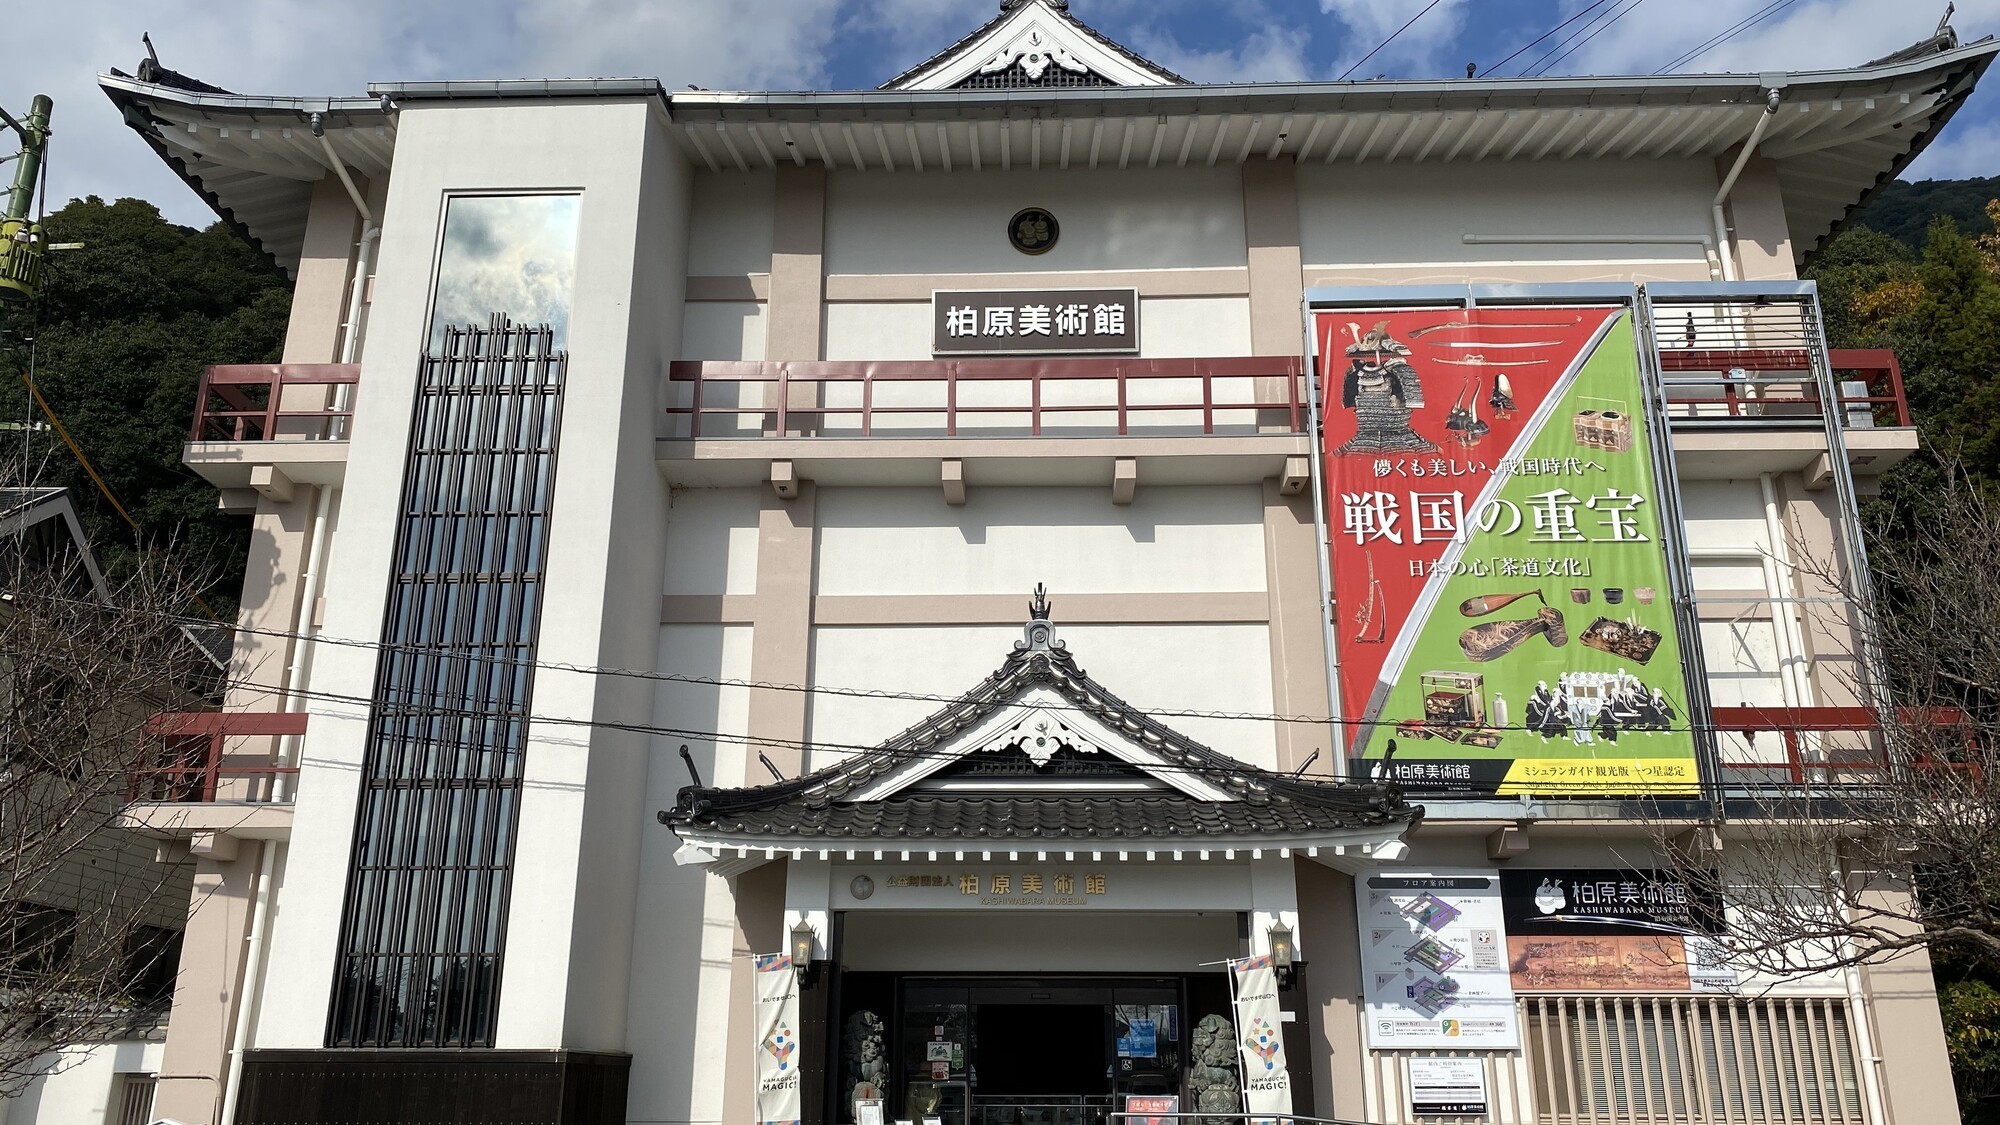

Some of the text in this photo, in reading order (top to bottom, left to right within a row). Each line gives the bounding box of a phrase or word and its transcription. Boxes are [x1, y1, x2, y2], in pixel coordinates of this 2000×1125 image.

[945, 303, 1126, 337] 柏原美術館
[1372, 456, 1606, 478] 儚くも美しい、戦国時代へ
[1340, 487, 1651, 545] 戦国の重宝
[1408, 557, 1592, 578] 日本の心「茶道文化」
[1395, 763, 1471, 780] 柏原美術館
[958, 873, 1107, 895] 柏原美術館
[1571, 881, 1687, 904] 柏原美術館
[980, 897, 1088, 905] KASHIWABARA MUSEUM
[1573, 906, 1645, 914] KASHIWABARA
[762, 1081, 796, 1091] MAGIC!
[1250, 1081, 1287, 1091] MAGIC!
